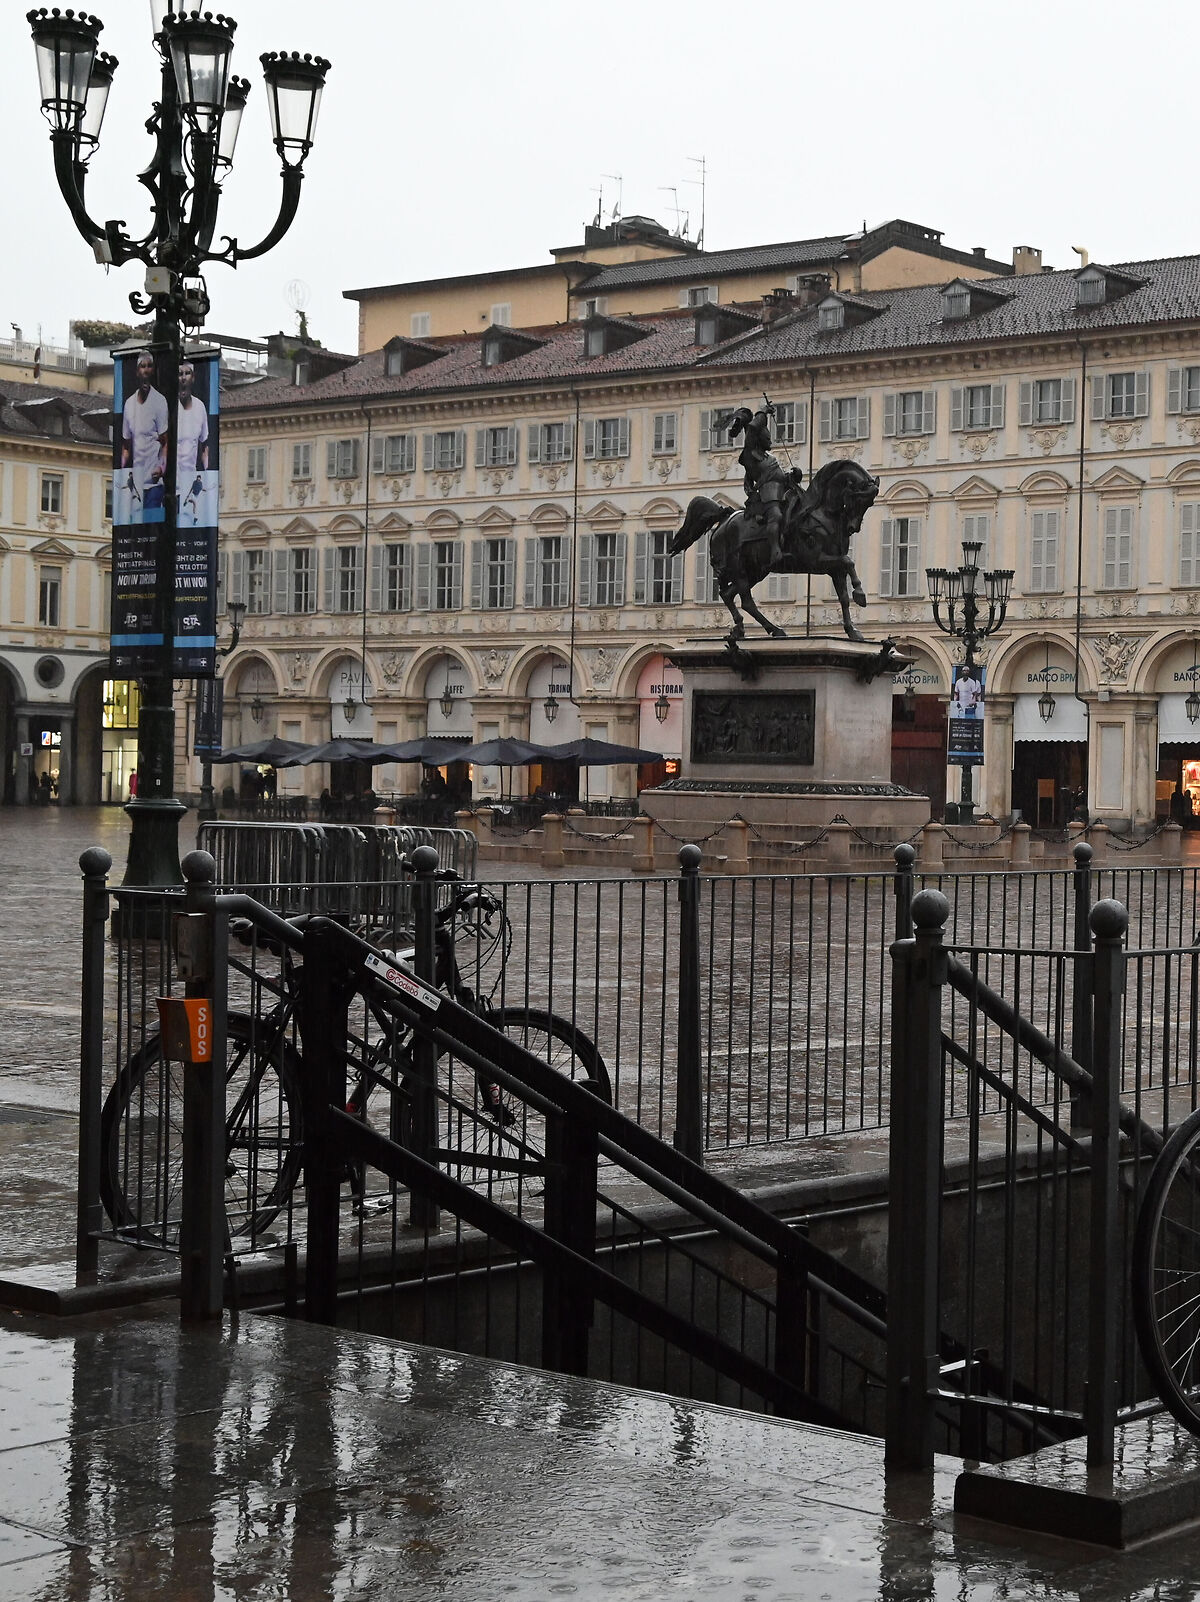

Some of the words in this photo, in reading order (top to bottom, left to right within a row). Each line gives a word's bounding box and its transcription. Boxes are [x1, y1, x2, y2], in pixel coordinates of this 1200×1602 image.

[892, 675, 921, 684] BANCO
[922, 675, 939, 684] BPM
[1027, 673, 1059, 683] BANCO
[650, 684, 684, 694] RISTORAN
[197, 1007, 208, 1056] SOS
